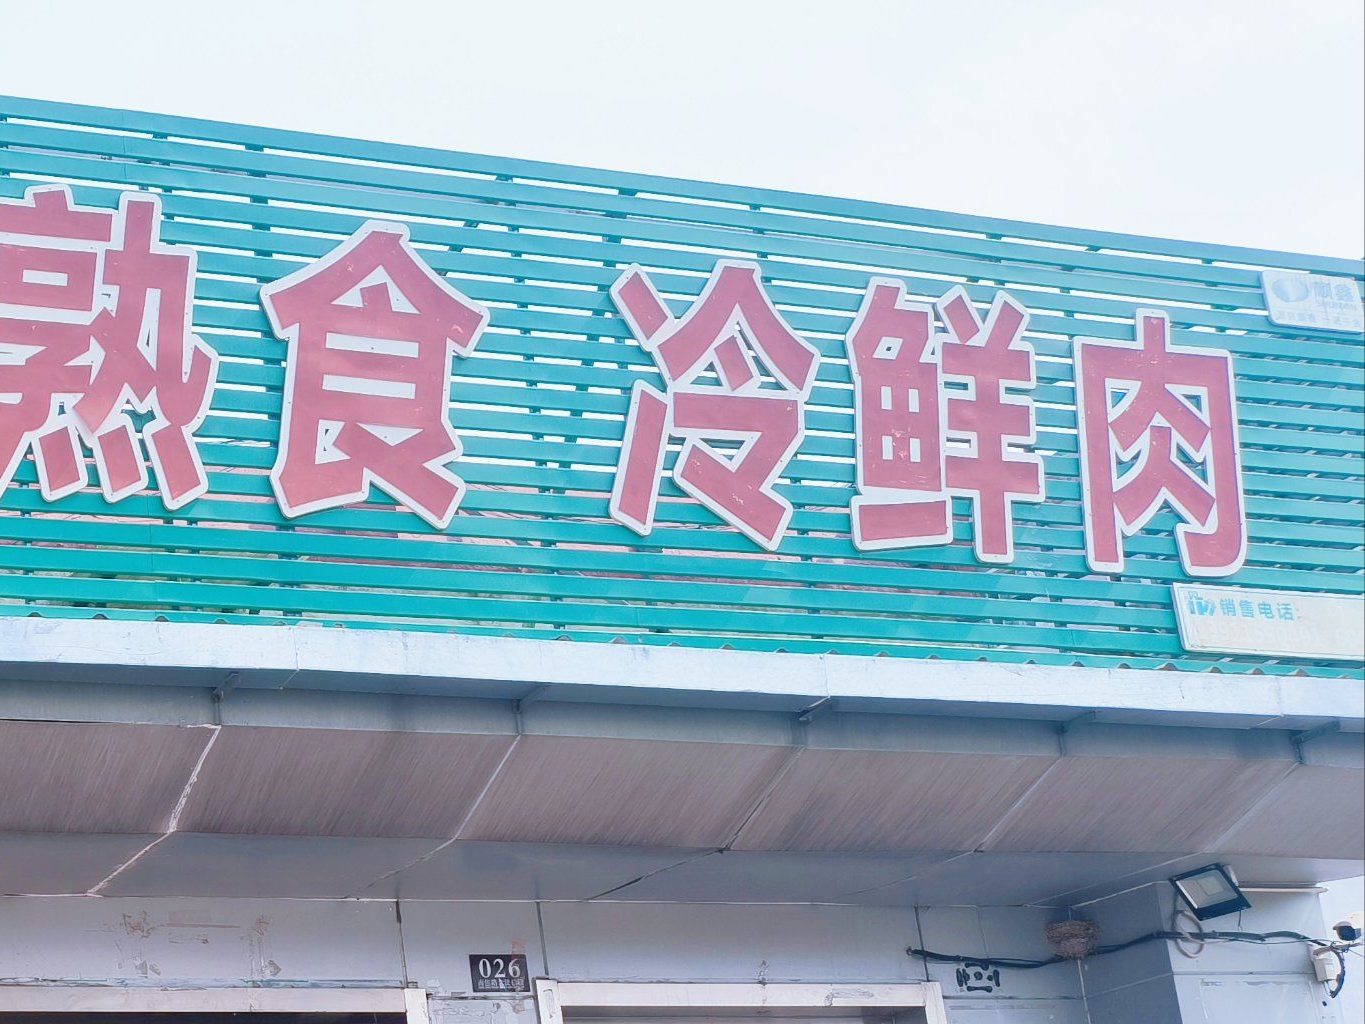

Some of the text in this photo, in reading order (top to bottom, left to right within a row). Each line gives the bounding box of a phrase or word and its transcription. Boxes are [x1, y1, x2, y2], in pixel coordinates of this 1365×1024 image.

[610, 259, 1248, 577] 冷鲜肉
[478, 958, 521, 978] 026
